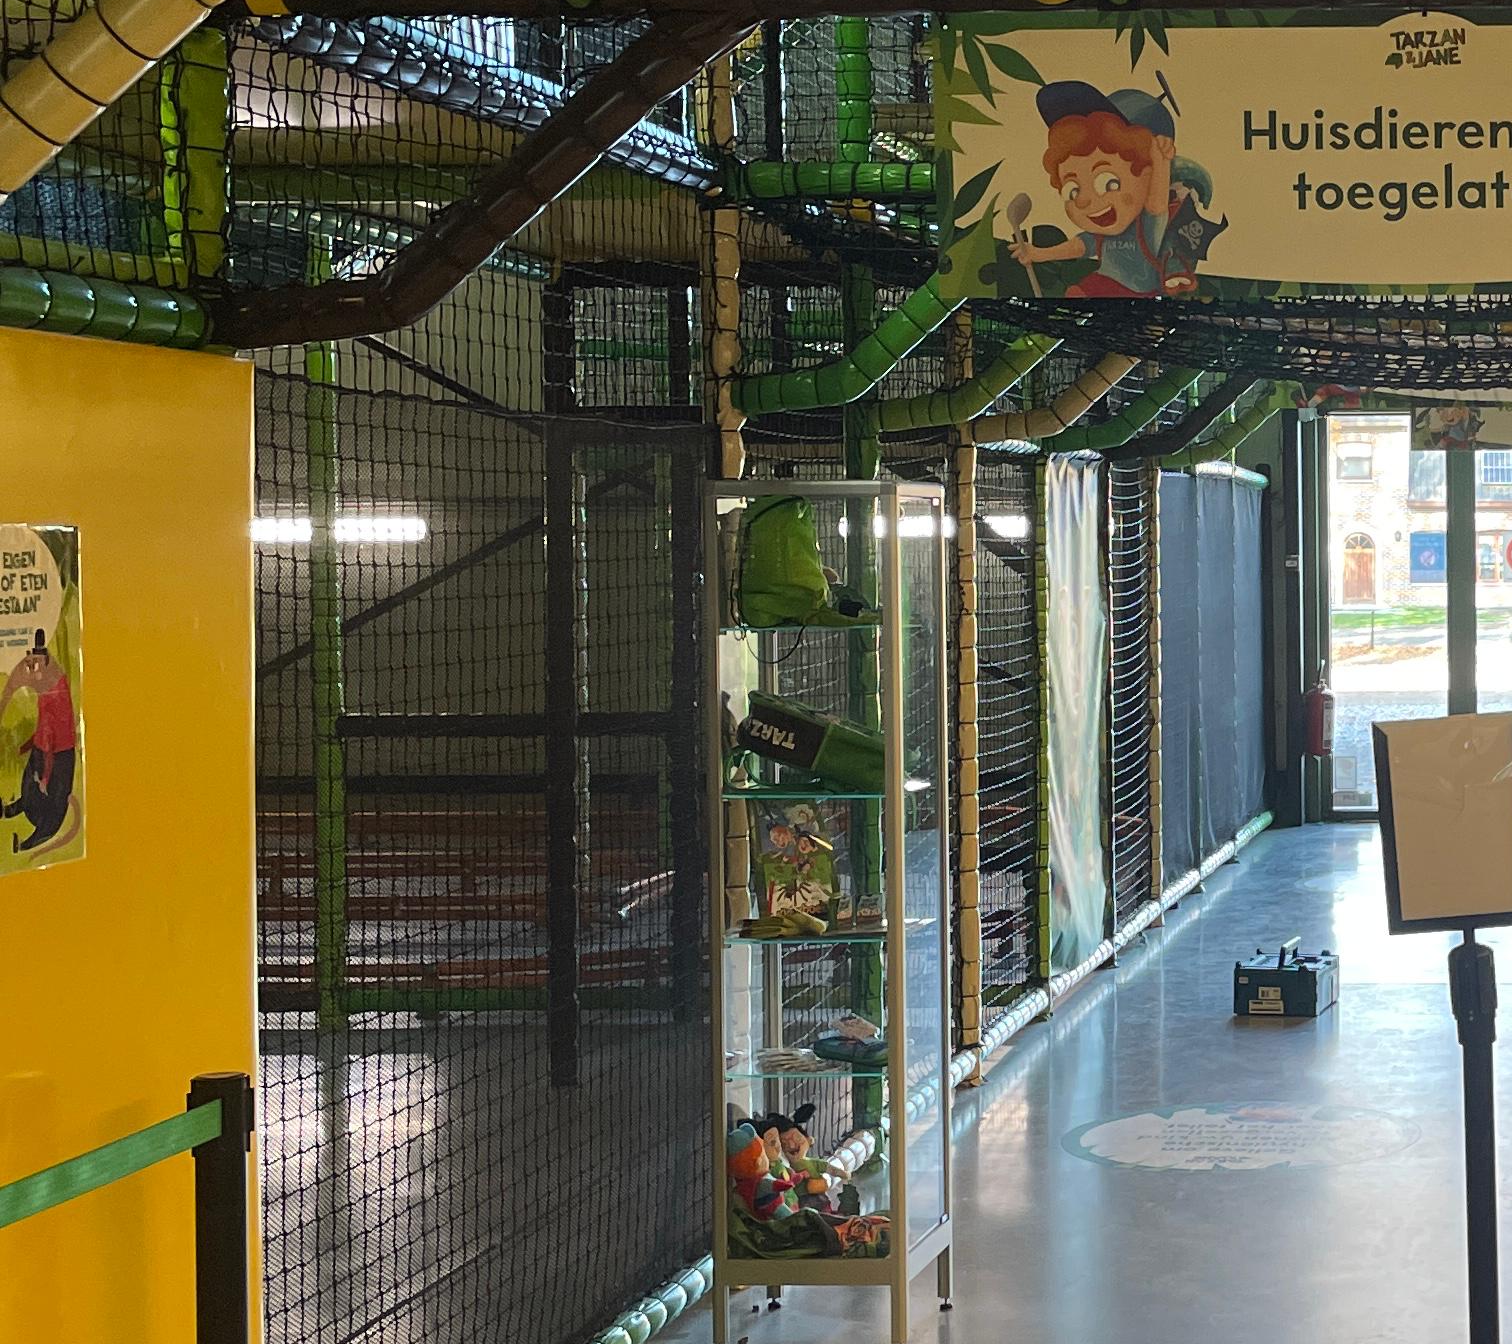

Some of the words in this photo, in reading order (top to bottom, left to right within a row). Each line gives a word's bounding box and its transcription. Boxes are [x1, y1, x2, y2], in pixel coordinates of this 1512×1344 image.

[1390, 28, 1466, 50] TARZAN
[1413, 47, 1461, 68] JANE
[3, 550, 36, 569] EIGEN
[1, 573, 16, 592] OF
[20, 572, 48, 592] ETEN
[748, 718, 796, 750] TARZ
